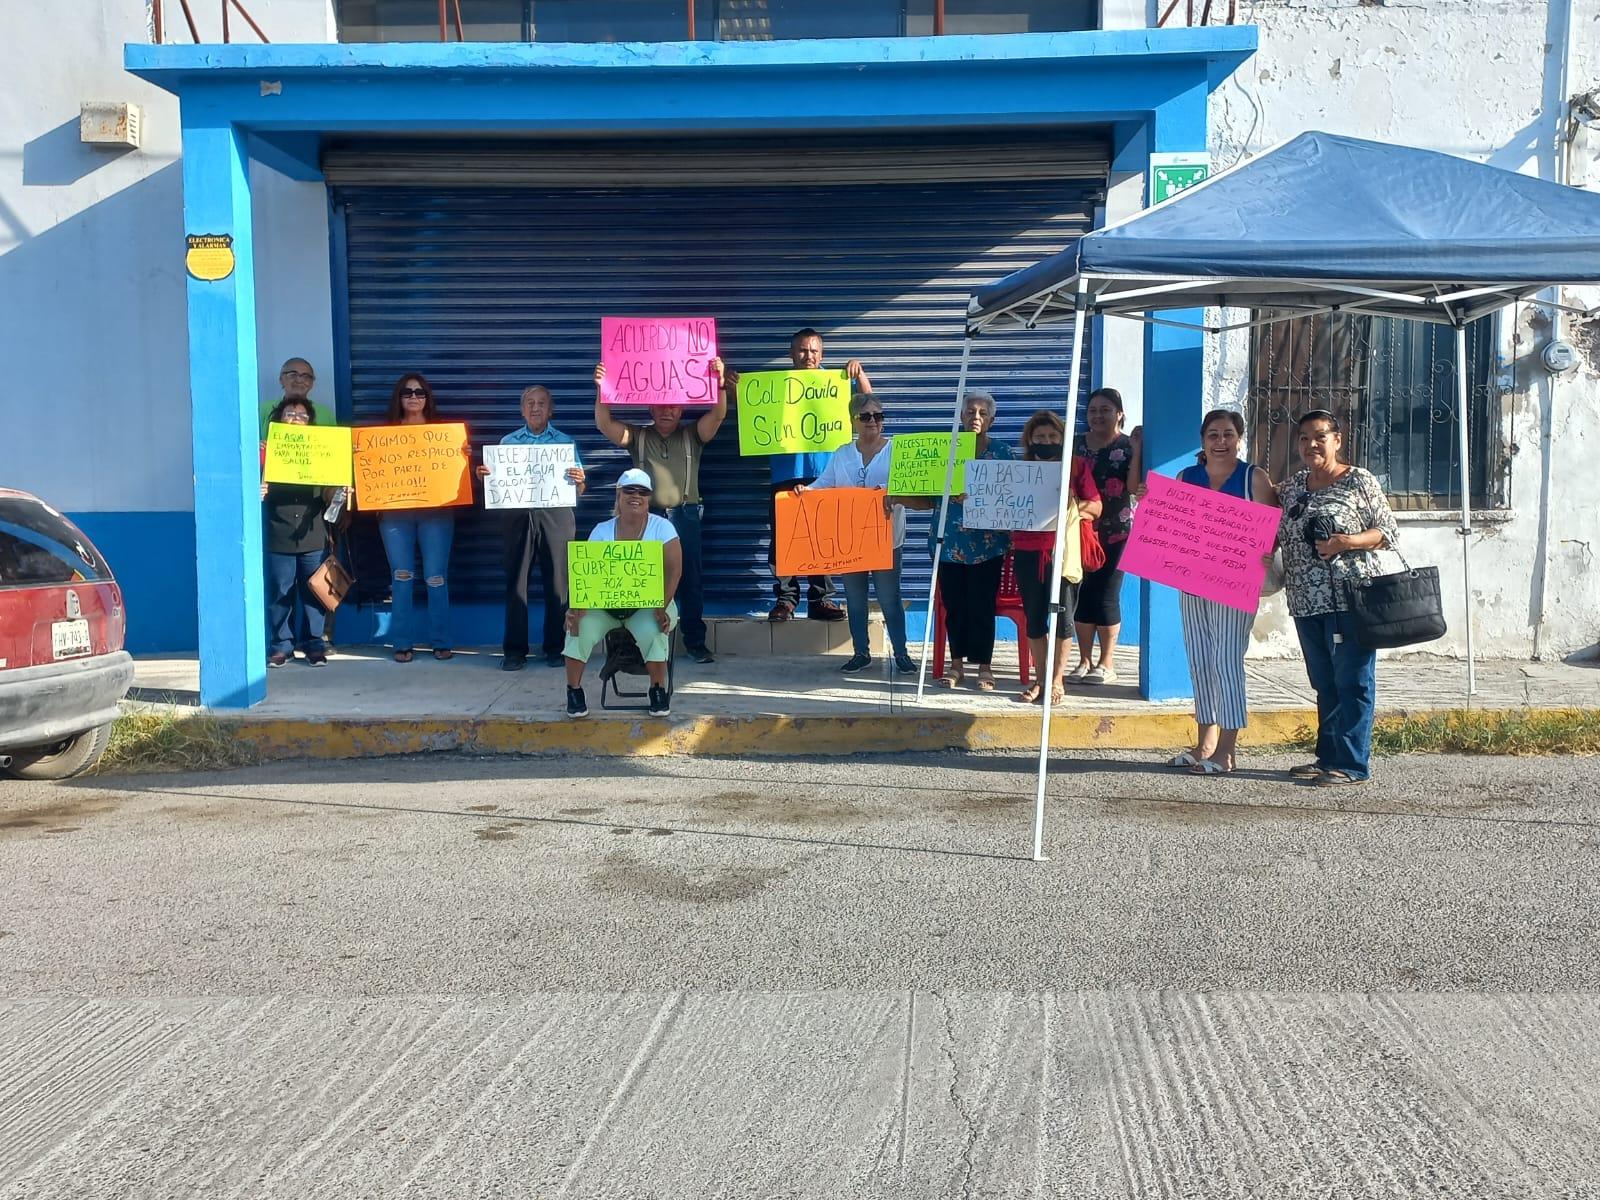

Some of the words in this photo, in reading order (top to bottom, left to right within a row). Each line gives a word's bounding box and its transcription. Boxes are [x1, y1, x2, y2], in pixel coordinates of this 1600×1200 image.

[609, 323, 678, 353] ACUERDO
[784, 376, 838, 405] Dávila
[423, 430, 453, 443] QUE
[753, 415, 796, 446] Sin
[801, 412, 842, 444] Agua
[378, 454, 402, 465] NOS
[486, 447, 573, 464] NECESITAMOS
[902, 451, 911, 460] EL
[915, 448, 940, 460] AGUA
[362, 468, 385, 481] POR
[394, 464, 422, 476] PARTE
[431, 462, 449, 471] DE
[506, 466, 520, 476] EL
[524, 463, 555, 478] AGUA
[893, 470, 928, 478] COLONIA
[970, 463, 988, 482] YA
[996, 463, 1044, 485] BASTA
[489, 475, 545, 487] COLONIA
[892, 480, 953, 492] DAVIL
[488, 485, 560, 504] DAVILA
[968, 483, 1013, 496] DENOS
[975, 497, 988, 507] EL
[994, 494, 1034, 509] AGUA
[965, 507, 988, 519] POR
[996, 507, 1036, 519] FAVOR
[575, 545, 592, 559] EL
[602, 542, 643, 560] AGUA
[572, 560, 617, 577] CUBRE
[624, 561, 656, 577] CASI
[575, 579, 592, 591] EL
[602, 576, 623, 589] 70%
[631, 578, 648, 588] DE
[575, 592, 589, 604] LA
[600, 590, 640, 600] TIERRA
[603, 599, 664, 609] NECESITAMOS
